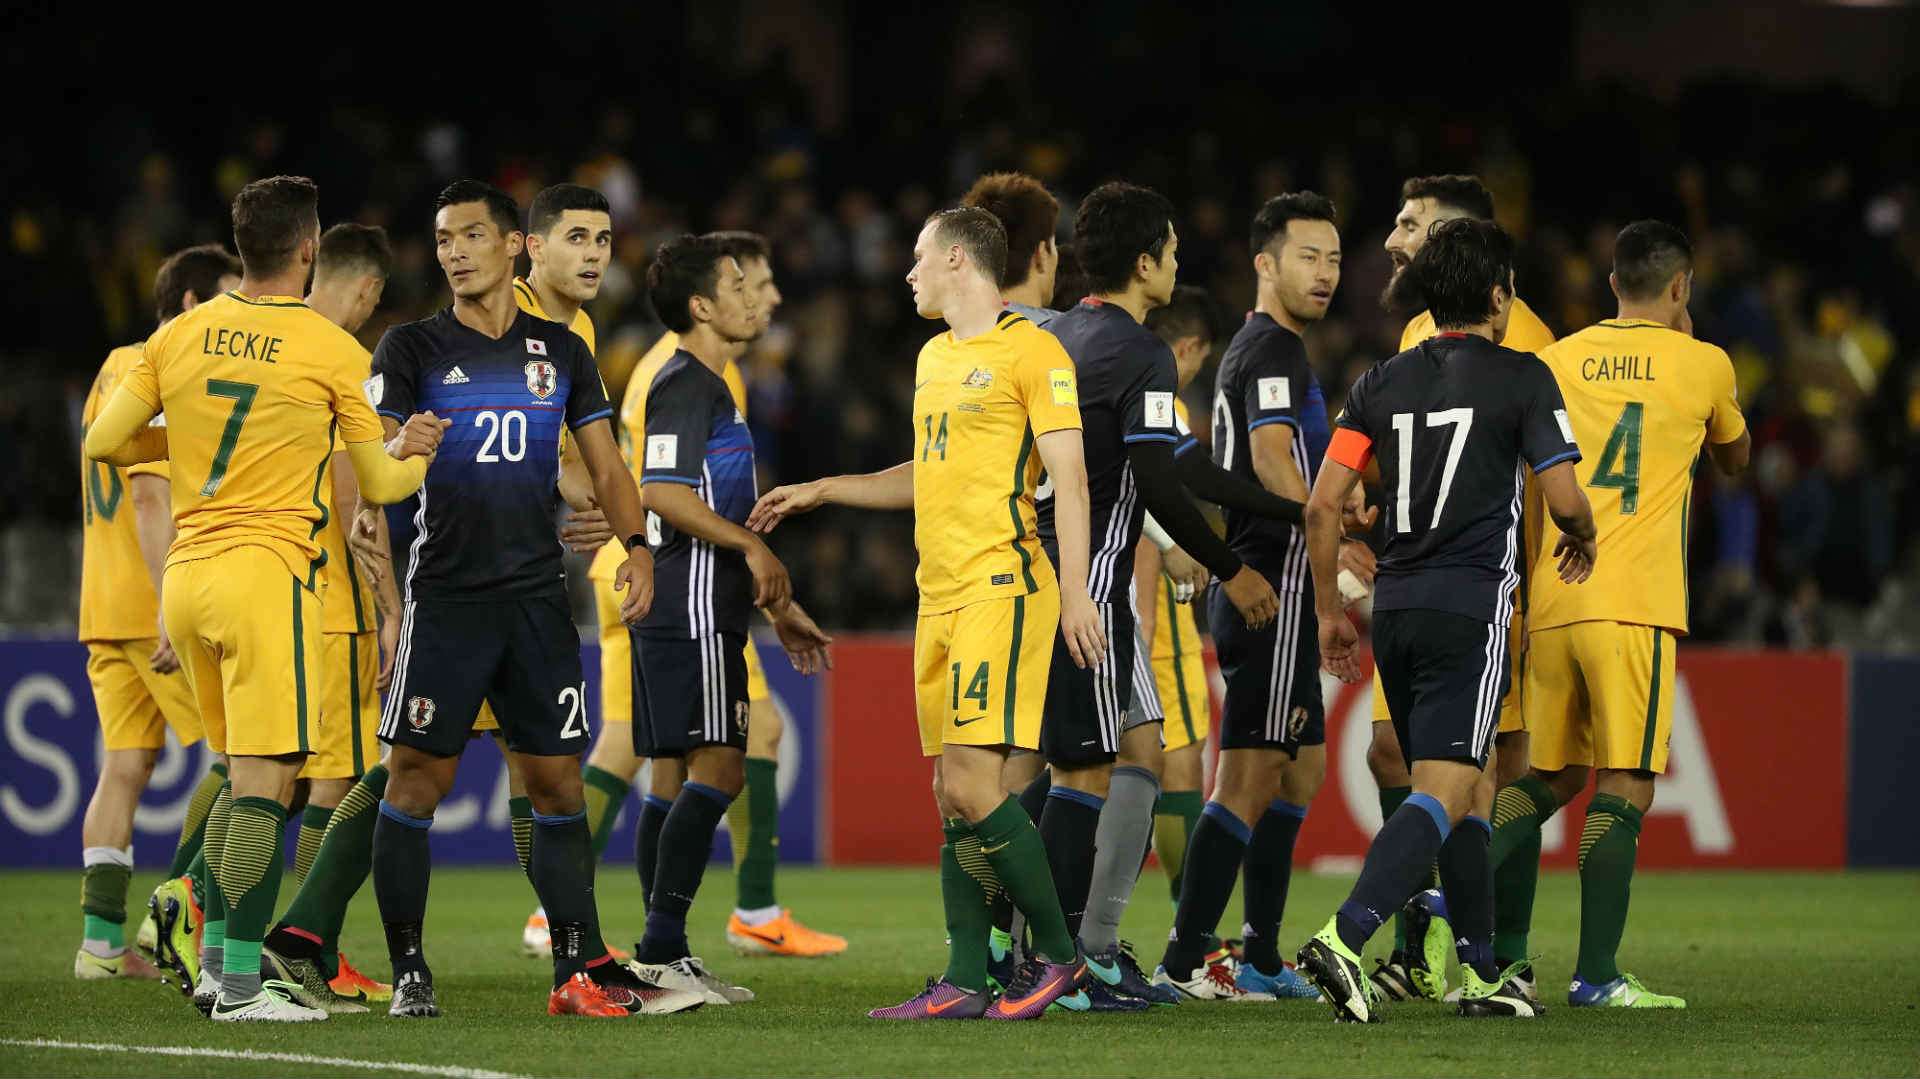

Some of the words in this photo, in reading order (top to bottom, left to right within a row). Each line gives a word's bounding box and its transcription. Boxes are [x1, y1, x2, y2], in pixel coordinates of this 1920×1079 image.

[203, 327, 284, 363] LECKIE
[1582, 355, 1656, 382] CAHILL
[201, 378, 260, 498] 7
[474, 410, 527, 463] 20
[922, 412, 949, 462] 14
[1587, 402, 1644, 516] 4
[1392, 407, 1473, 534] 17
[951, 661, 990, 711] 14
